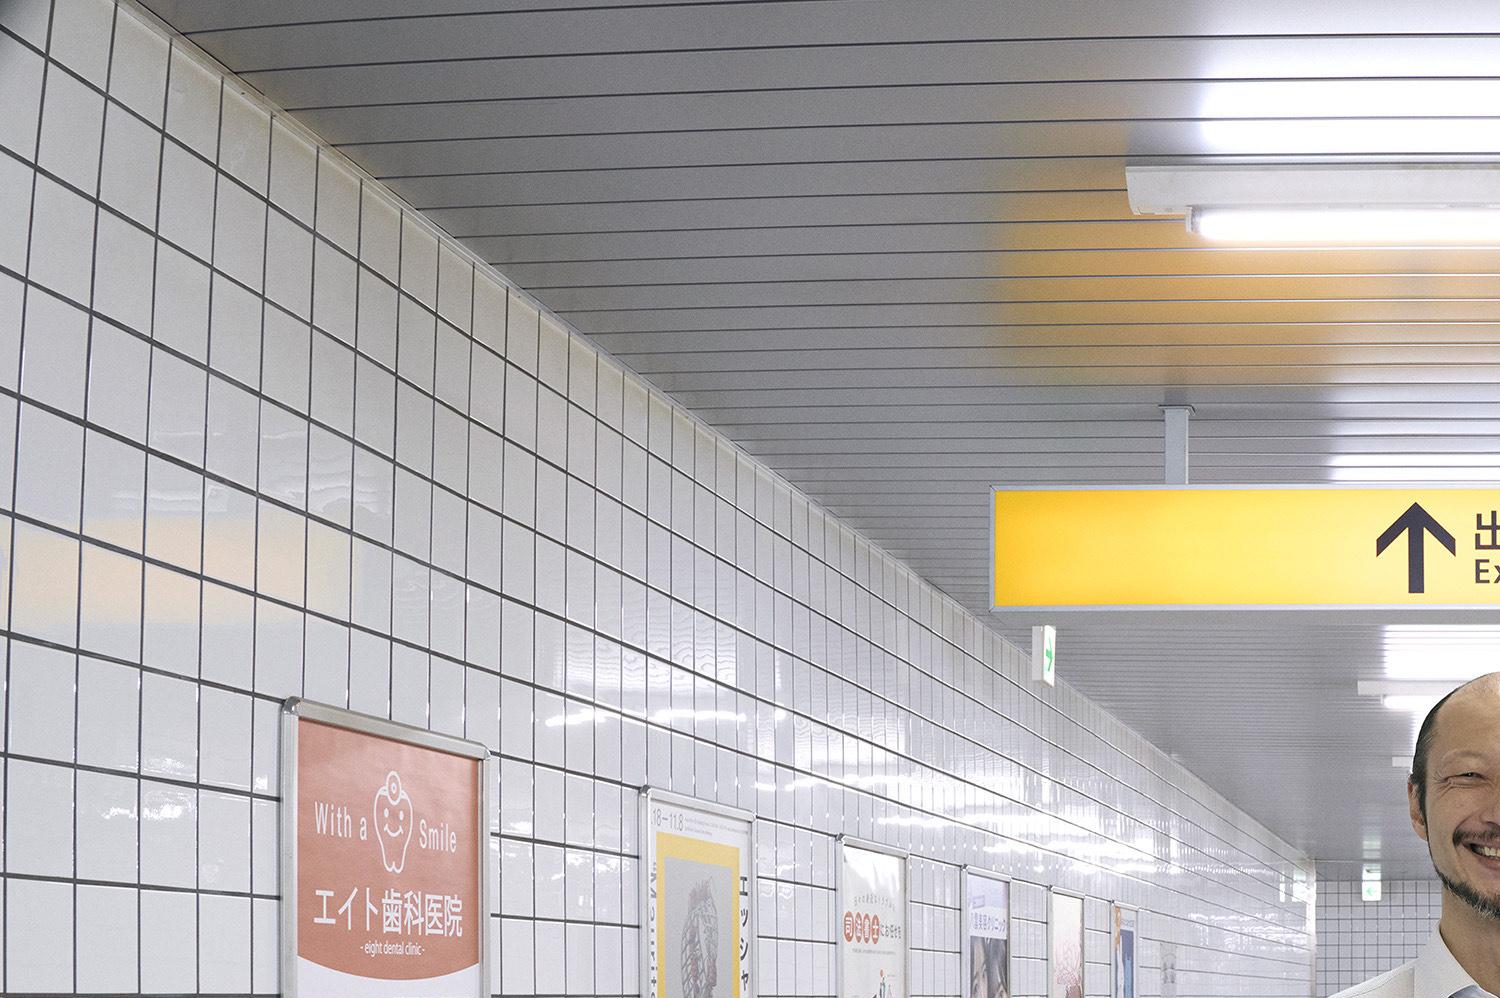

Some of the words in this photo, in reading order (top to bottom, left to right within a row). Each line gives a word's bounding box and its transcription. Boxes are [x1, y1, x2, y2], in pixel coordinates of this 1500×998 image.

[314, 801, 352, 838] With
[359, 816, 368, 841] a
[419, 819, 458, 853] Smile
[313, 887, 463, 938] エイト歯科医院
[364, 940, 384, 958] eight
[384, 940, 405, 956] dental
[405, 942, 422, 956] clinic
